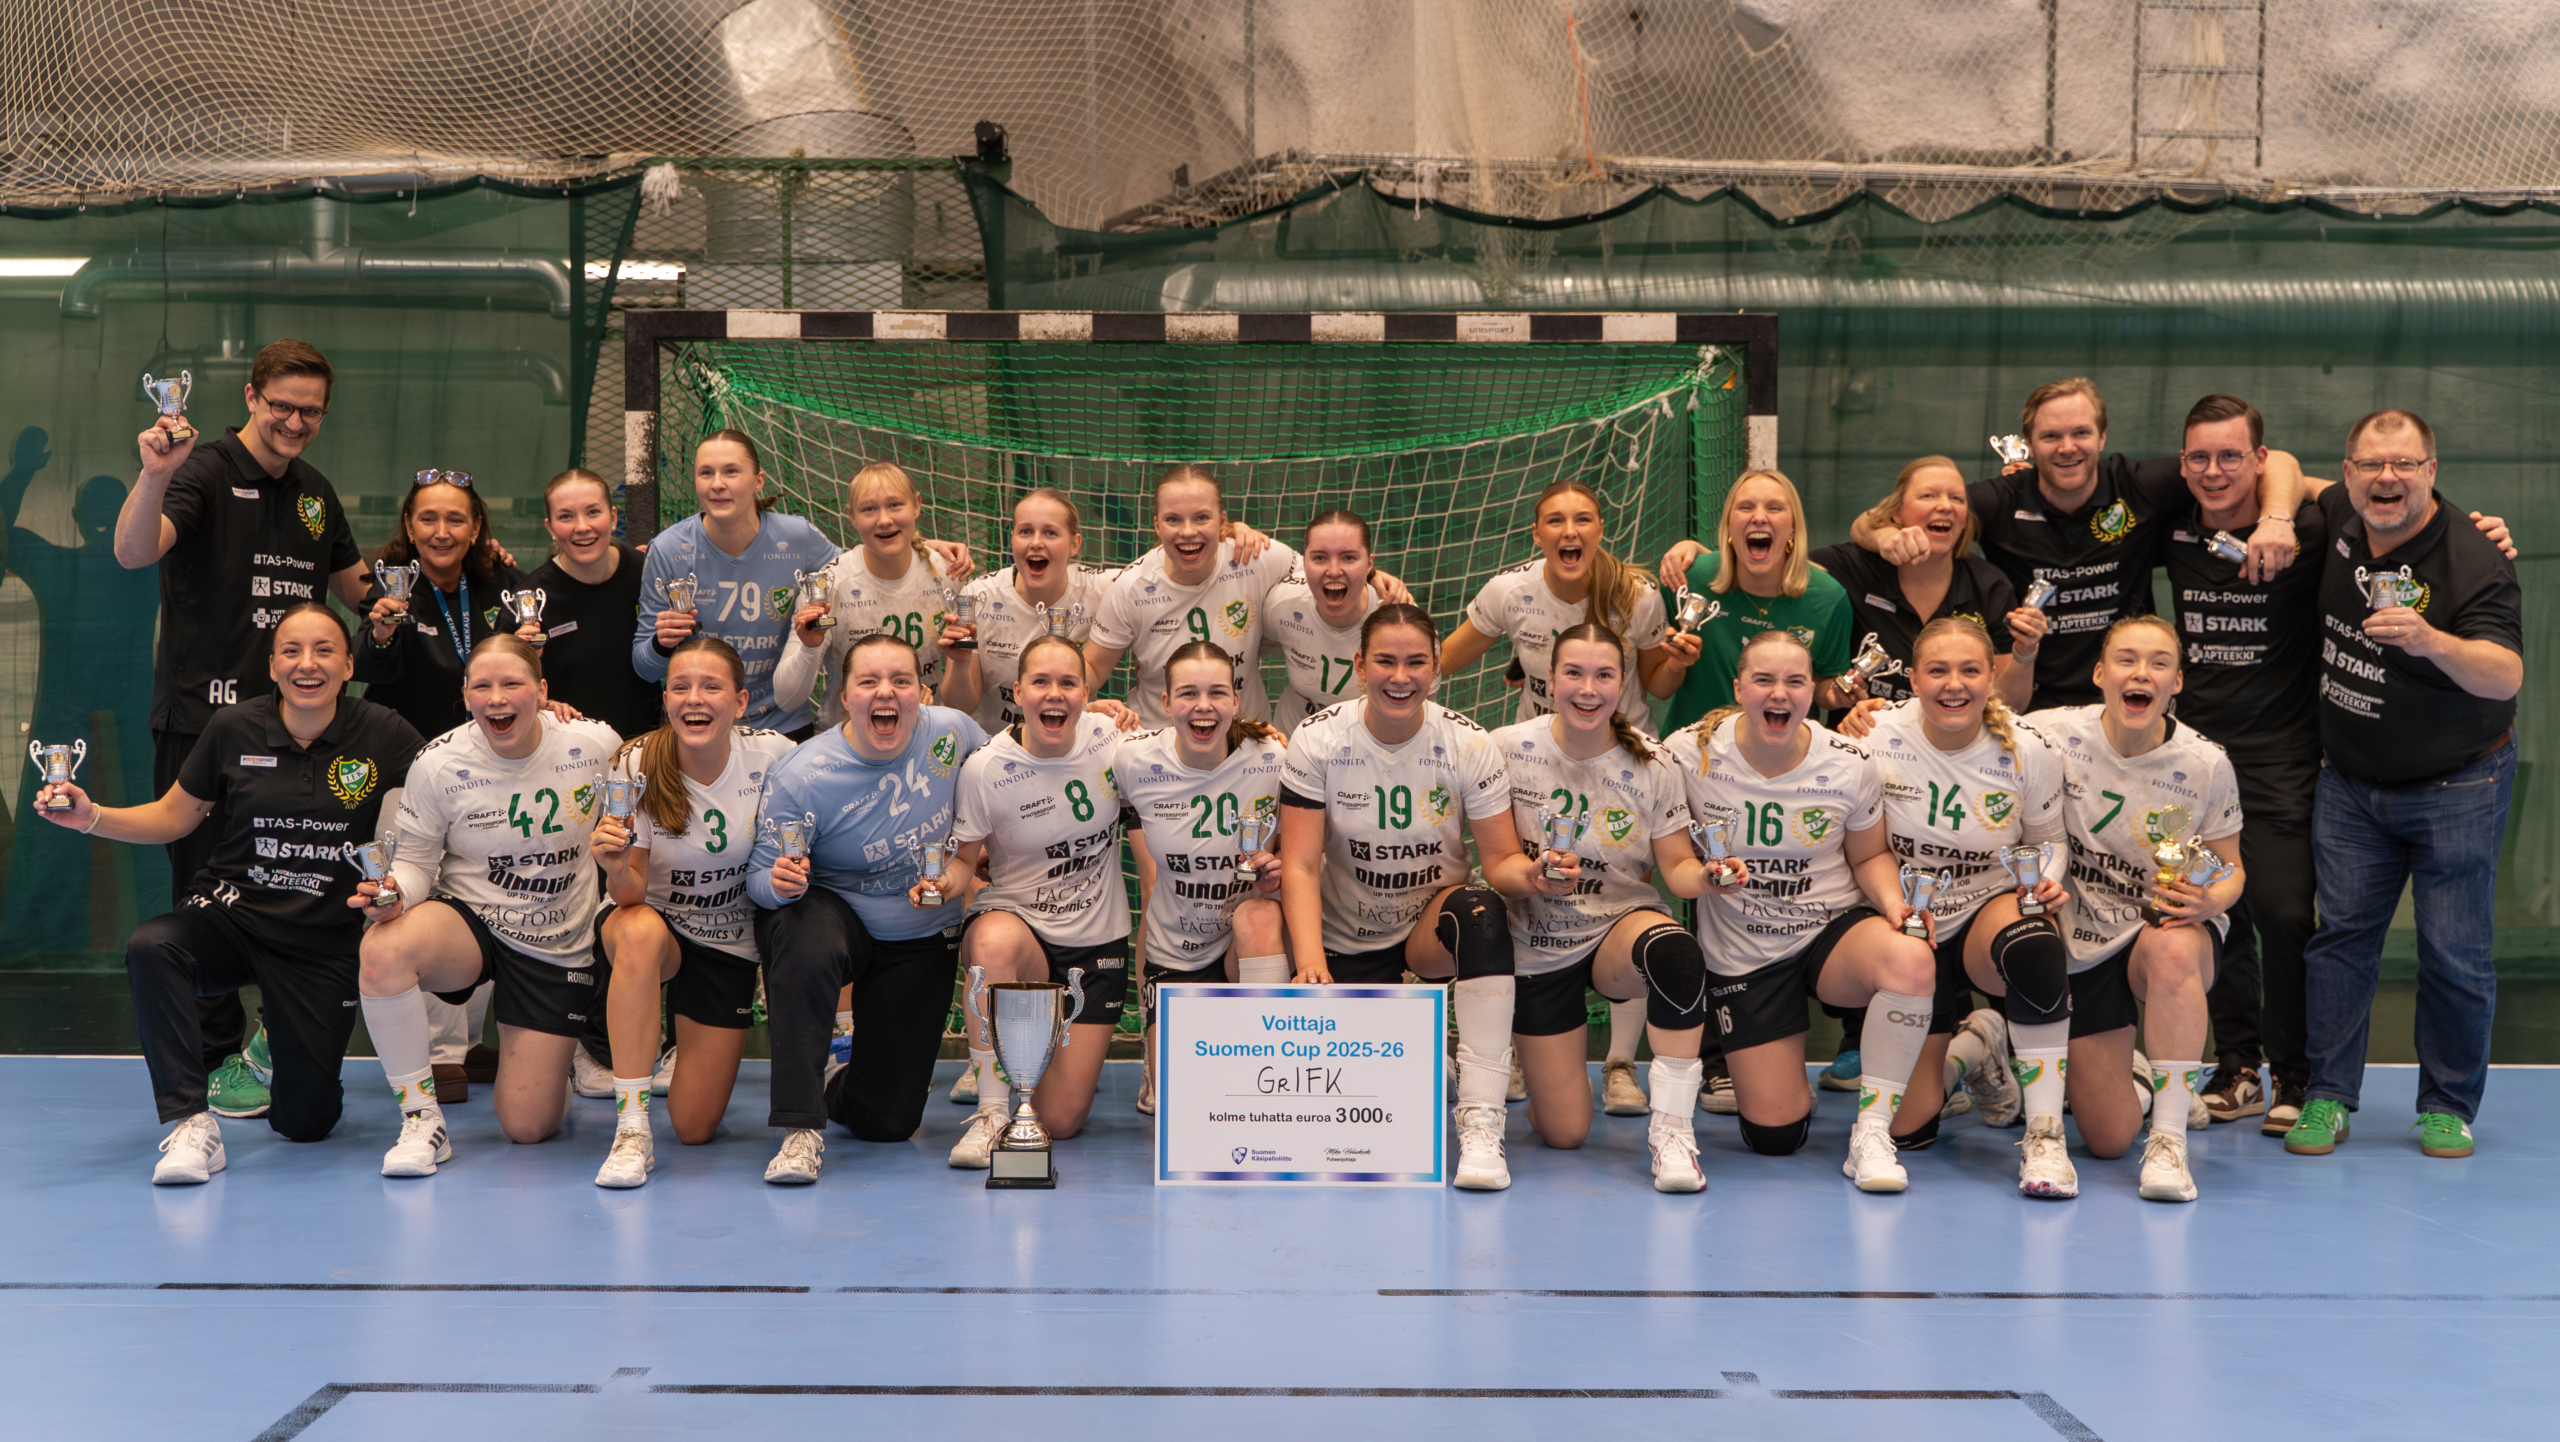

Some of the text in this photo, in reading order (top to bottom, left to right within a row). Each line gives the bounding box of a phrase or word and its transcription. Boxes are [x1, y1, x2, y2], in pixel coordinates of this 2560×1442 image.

[261, 554, 314, 570] TAS-Power
[2044, 561, 2120, 579] TAS-Power
[273, 581, 313, 599] STARK
[2059, 582, 2120, 603] STARK
[2192, 590, 2268, 603] TAS-Power
[717, 581, 761, 622] 79
[840, 600, 878, 609] FONDITA
[1507, 606, 1545, 616] FONDITA
[882, 612, 924, 650] 26
[1186, 607, 1210, 643] 9
[1279, 619, 1314, 636] FONDITA
[1741, 616, 1768, 628] CRAFT
[2059, 615, 2109, 629] APTEEKKI
[2206, 616, 2268, 632] STARK
[445, 611, 464, 654] VEIKKAUS
[462, 611, 471, 654] VEIKKAUS
[1519, 630, 1542, 640] CRAFT
[723, 635, 779, 650] STARK
[987, 641, 1012, 649] CRAFT
[2204, 651, 2255, 660] APTEEKKI
[1320, 654, 1354, 696] 17
[2336, 652, 2386, 684] STARK
[209, 679, 237, 704] AG
[2328, 688, 2371, 712] APTEEKKI
[1302, 706, 1342, 728] DSV
[1442, 710, 1482, 732] DSV
[1830, 737, 1870, 761] DSV
[1872, 749, 1918, 763] FONDITA
[556, 758, 599, 773] FONDITA
[1419, 758, 1456, 773] FONDITA
[1505, 752, 1549, 766] FONDITA
[802, 759, 848, 784] FONDITA
[993, 769, 1036, 789] FONDITA
[1138, 775, 1182, 784] FONDITA
[1242, 765, 1282, 775] FONDIT
[445, 778, 492, 794] FONDITA
[878, 757, 931, 818] 24
[1512, 787, 1539, 797] CRAFT
[1602, 778, 1645, 799] FONDITA
[1796, 786, 1843, 796] FONDITA
[1885, 782, 1914, 794] CRAFT
[2151, 778, 2198, 800] FONDITA
[842, 794, 870, 813] CRAFT
[1020, 798, 1046, 812] CRAFT
[1065, 779, 1095, 822] 8
[1374, 784, 1412, 830] 19
[1704, 802, 1733, 812] CRAFT
[1928, 779, 1967, 832] 14
[467, 810, 497, 820] CRAFT
[508, 787, 563, 838] 42
[1190, 792, 1239, 838] 20
[1546, 788, 1589, 841] 21
[2089, 789, 2125, 834] 7
[265, 818, 349, 831] TAS-Power
[469, 819, 507, 828] INTERSPORT
[703, 808, 728, 854] 3
[894, 801, 951, 850] STARK
[1745, 801, 1784, 847] 16
[279, 843, 342, 861] STARK
[519, 844, 580, 867] STARK
[1376, 841, 1443, 860] STARK
[1920, 843, 1994, 862] STARK
[700, 862, 749, 884] STAR
[1747, 857, 1812, 874] STARK
[1956, 879, 1971, 887] JOB
[530, 894, 545, 903] THE
[1262, 1015, 1336, 1035] Voittaja
[1716, 1005, 1733, 1035] 16
[1195, 1040, 1404, 1061] Suomen Cup 2025-26
[1209, 1112, 1246, 1122] kolme
[1249, 1112, 1293, 1122] tuhatta
[1296, 1114, 1331, 1123] euroa
